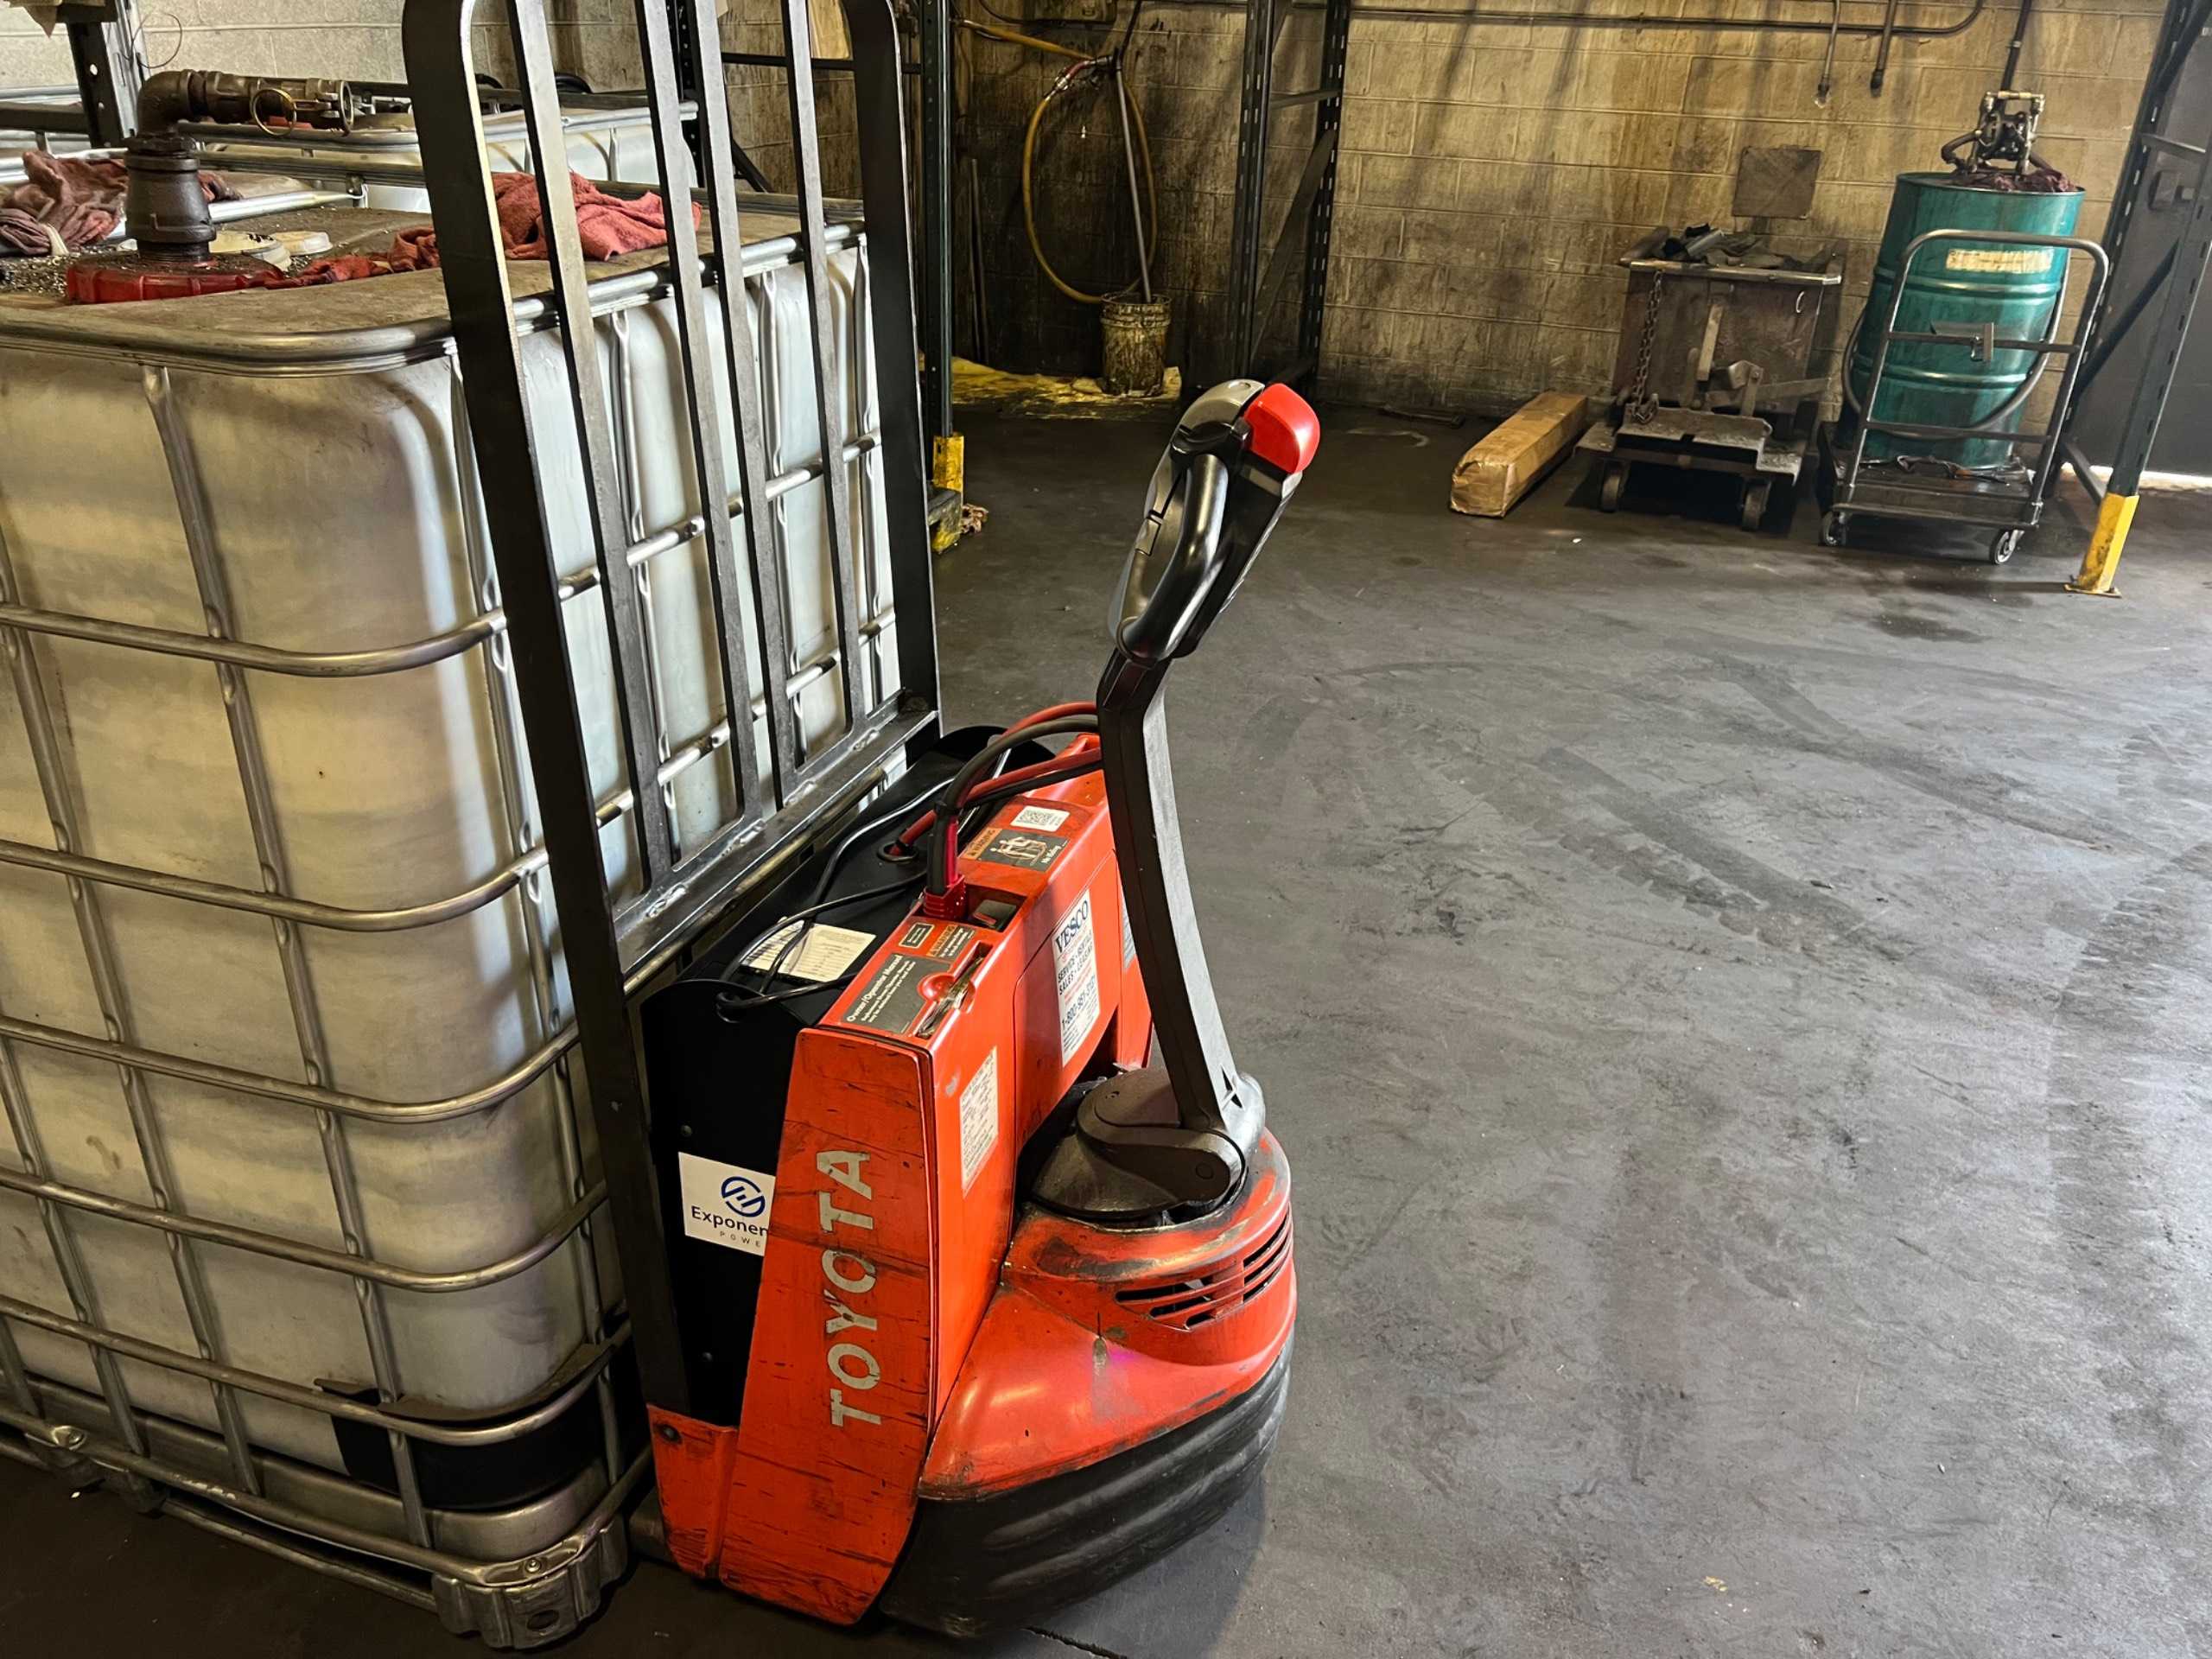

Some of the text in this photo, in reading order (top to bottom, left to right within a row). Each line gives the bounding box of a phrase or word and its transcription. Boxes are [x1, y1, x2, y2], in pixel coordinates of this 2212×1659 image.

[1055, 899, 1088, 954] VESCO
[1059, 969, 1074, 995] SALES
[817, 1150, 882, 1427] TOYOTA
